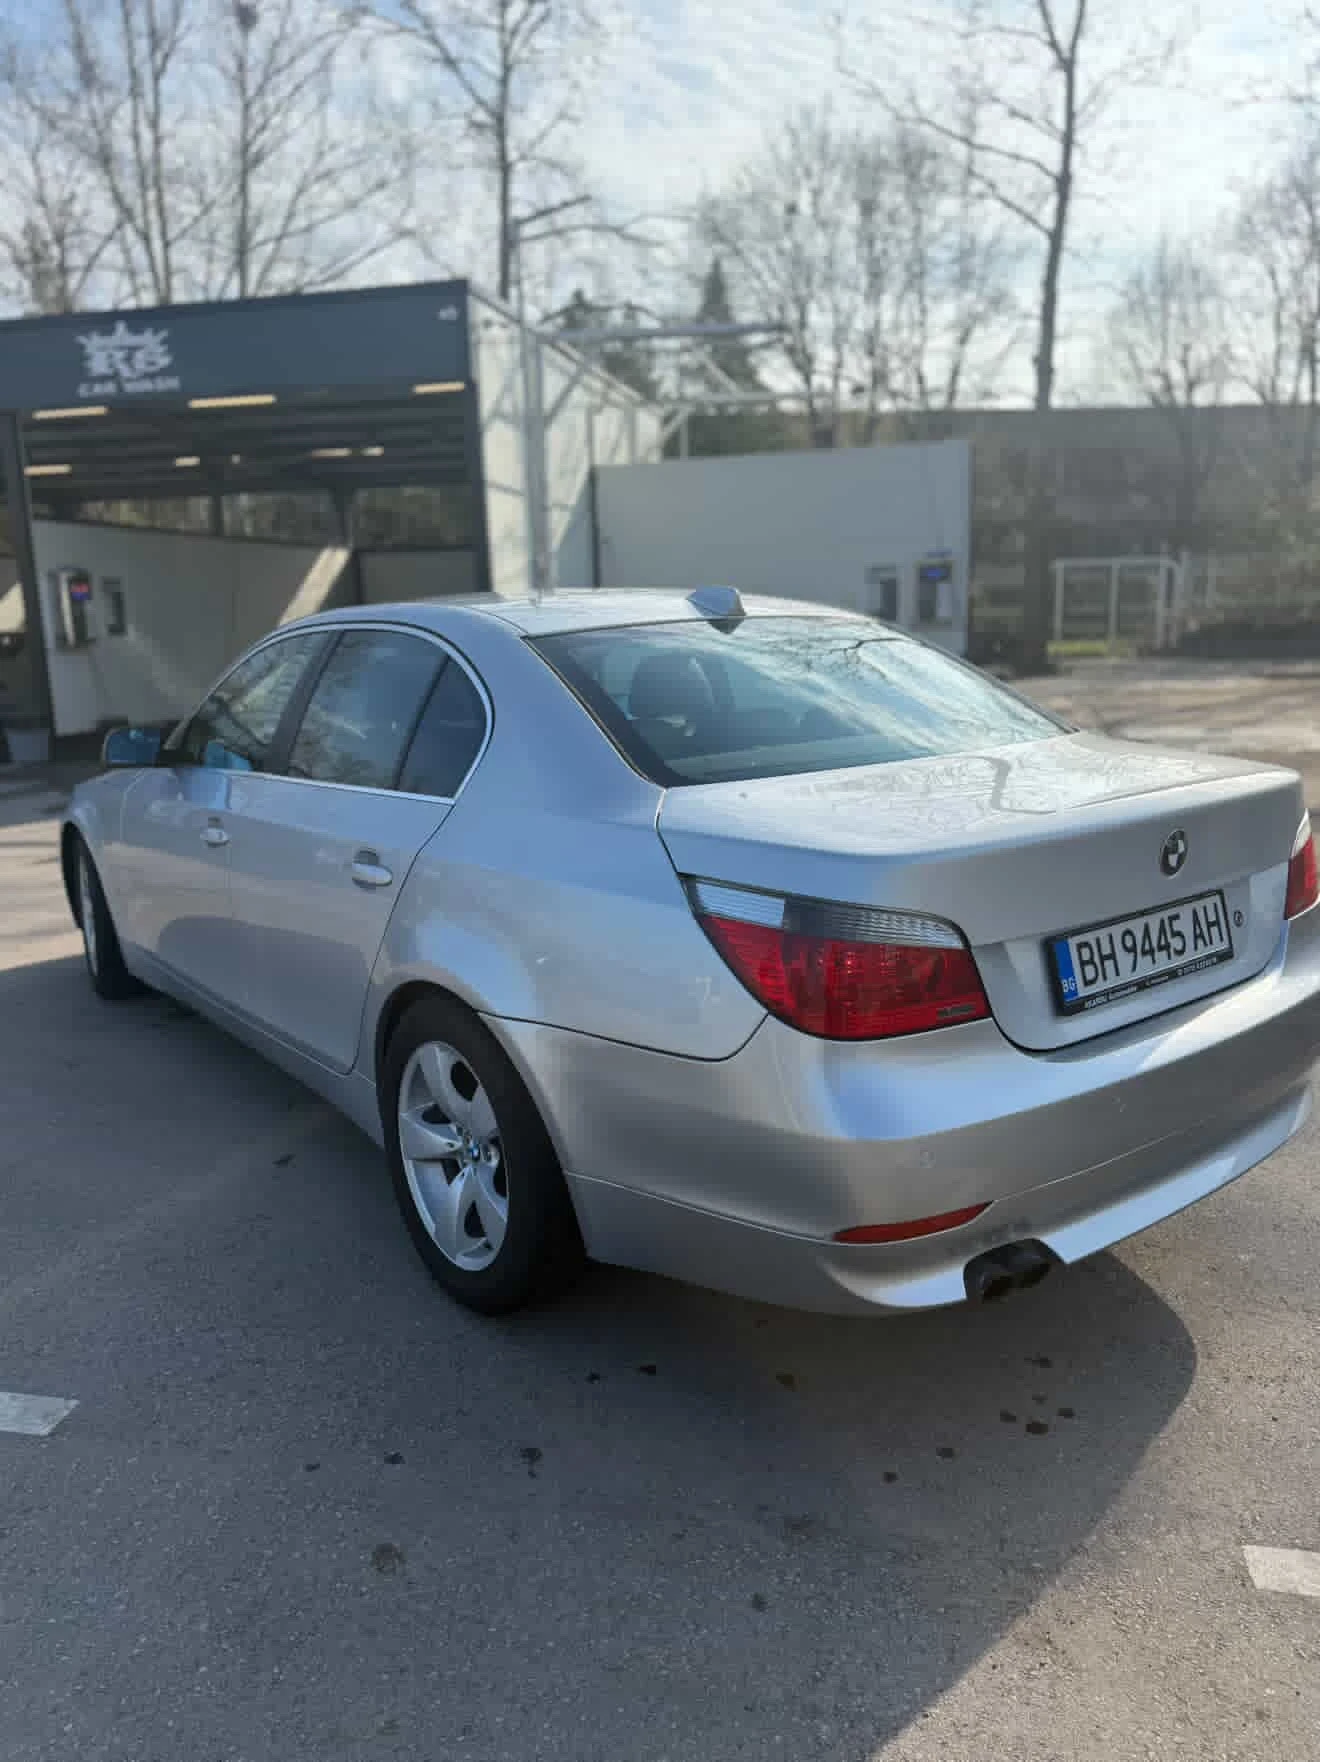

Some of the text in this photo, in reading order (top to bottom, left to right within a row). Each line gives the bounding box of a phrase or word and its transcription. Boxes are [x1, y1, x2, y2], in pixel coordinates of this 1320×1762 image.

[1077, 933, 1120, 987] BH
[1121, 915, 1187, 972] 9445
[1192, 903, 1224, 950] AH
[1062, 978, 1076, 993] BG
